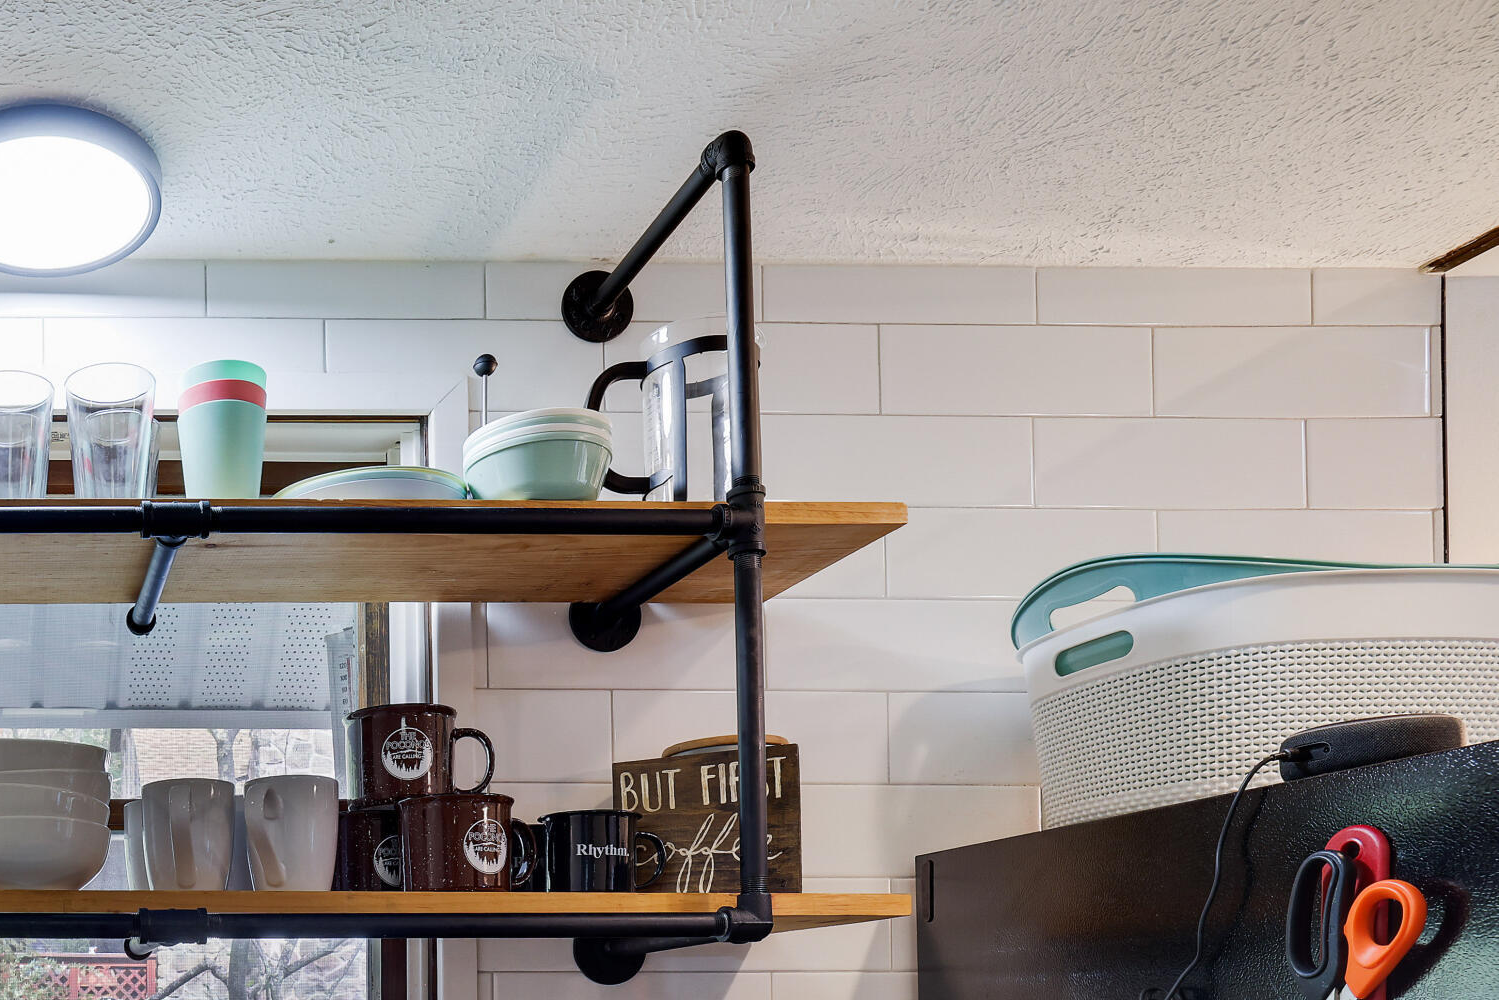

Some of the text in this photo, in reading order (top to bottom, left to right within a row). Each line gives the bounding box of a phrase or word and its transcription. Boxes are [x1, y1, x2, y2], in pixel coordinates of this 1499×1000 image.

[619, 756, 787, 812] BUT FIT
[576, 843, 630, 859] Rhythm.
